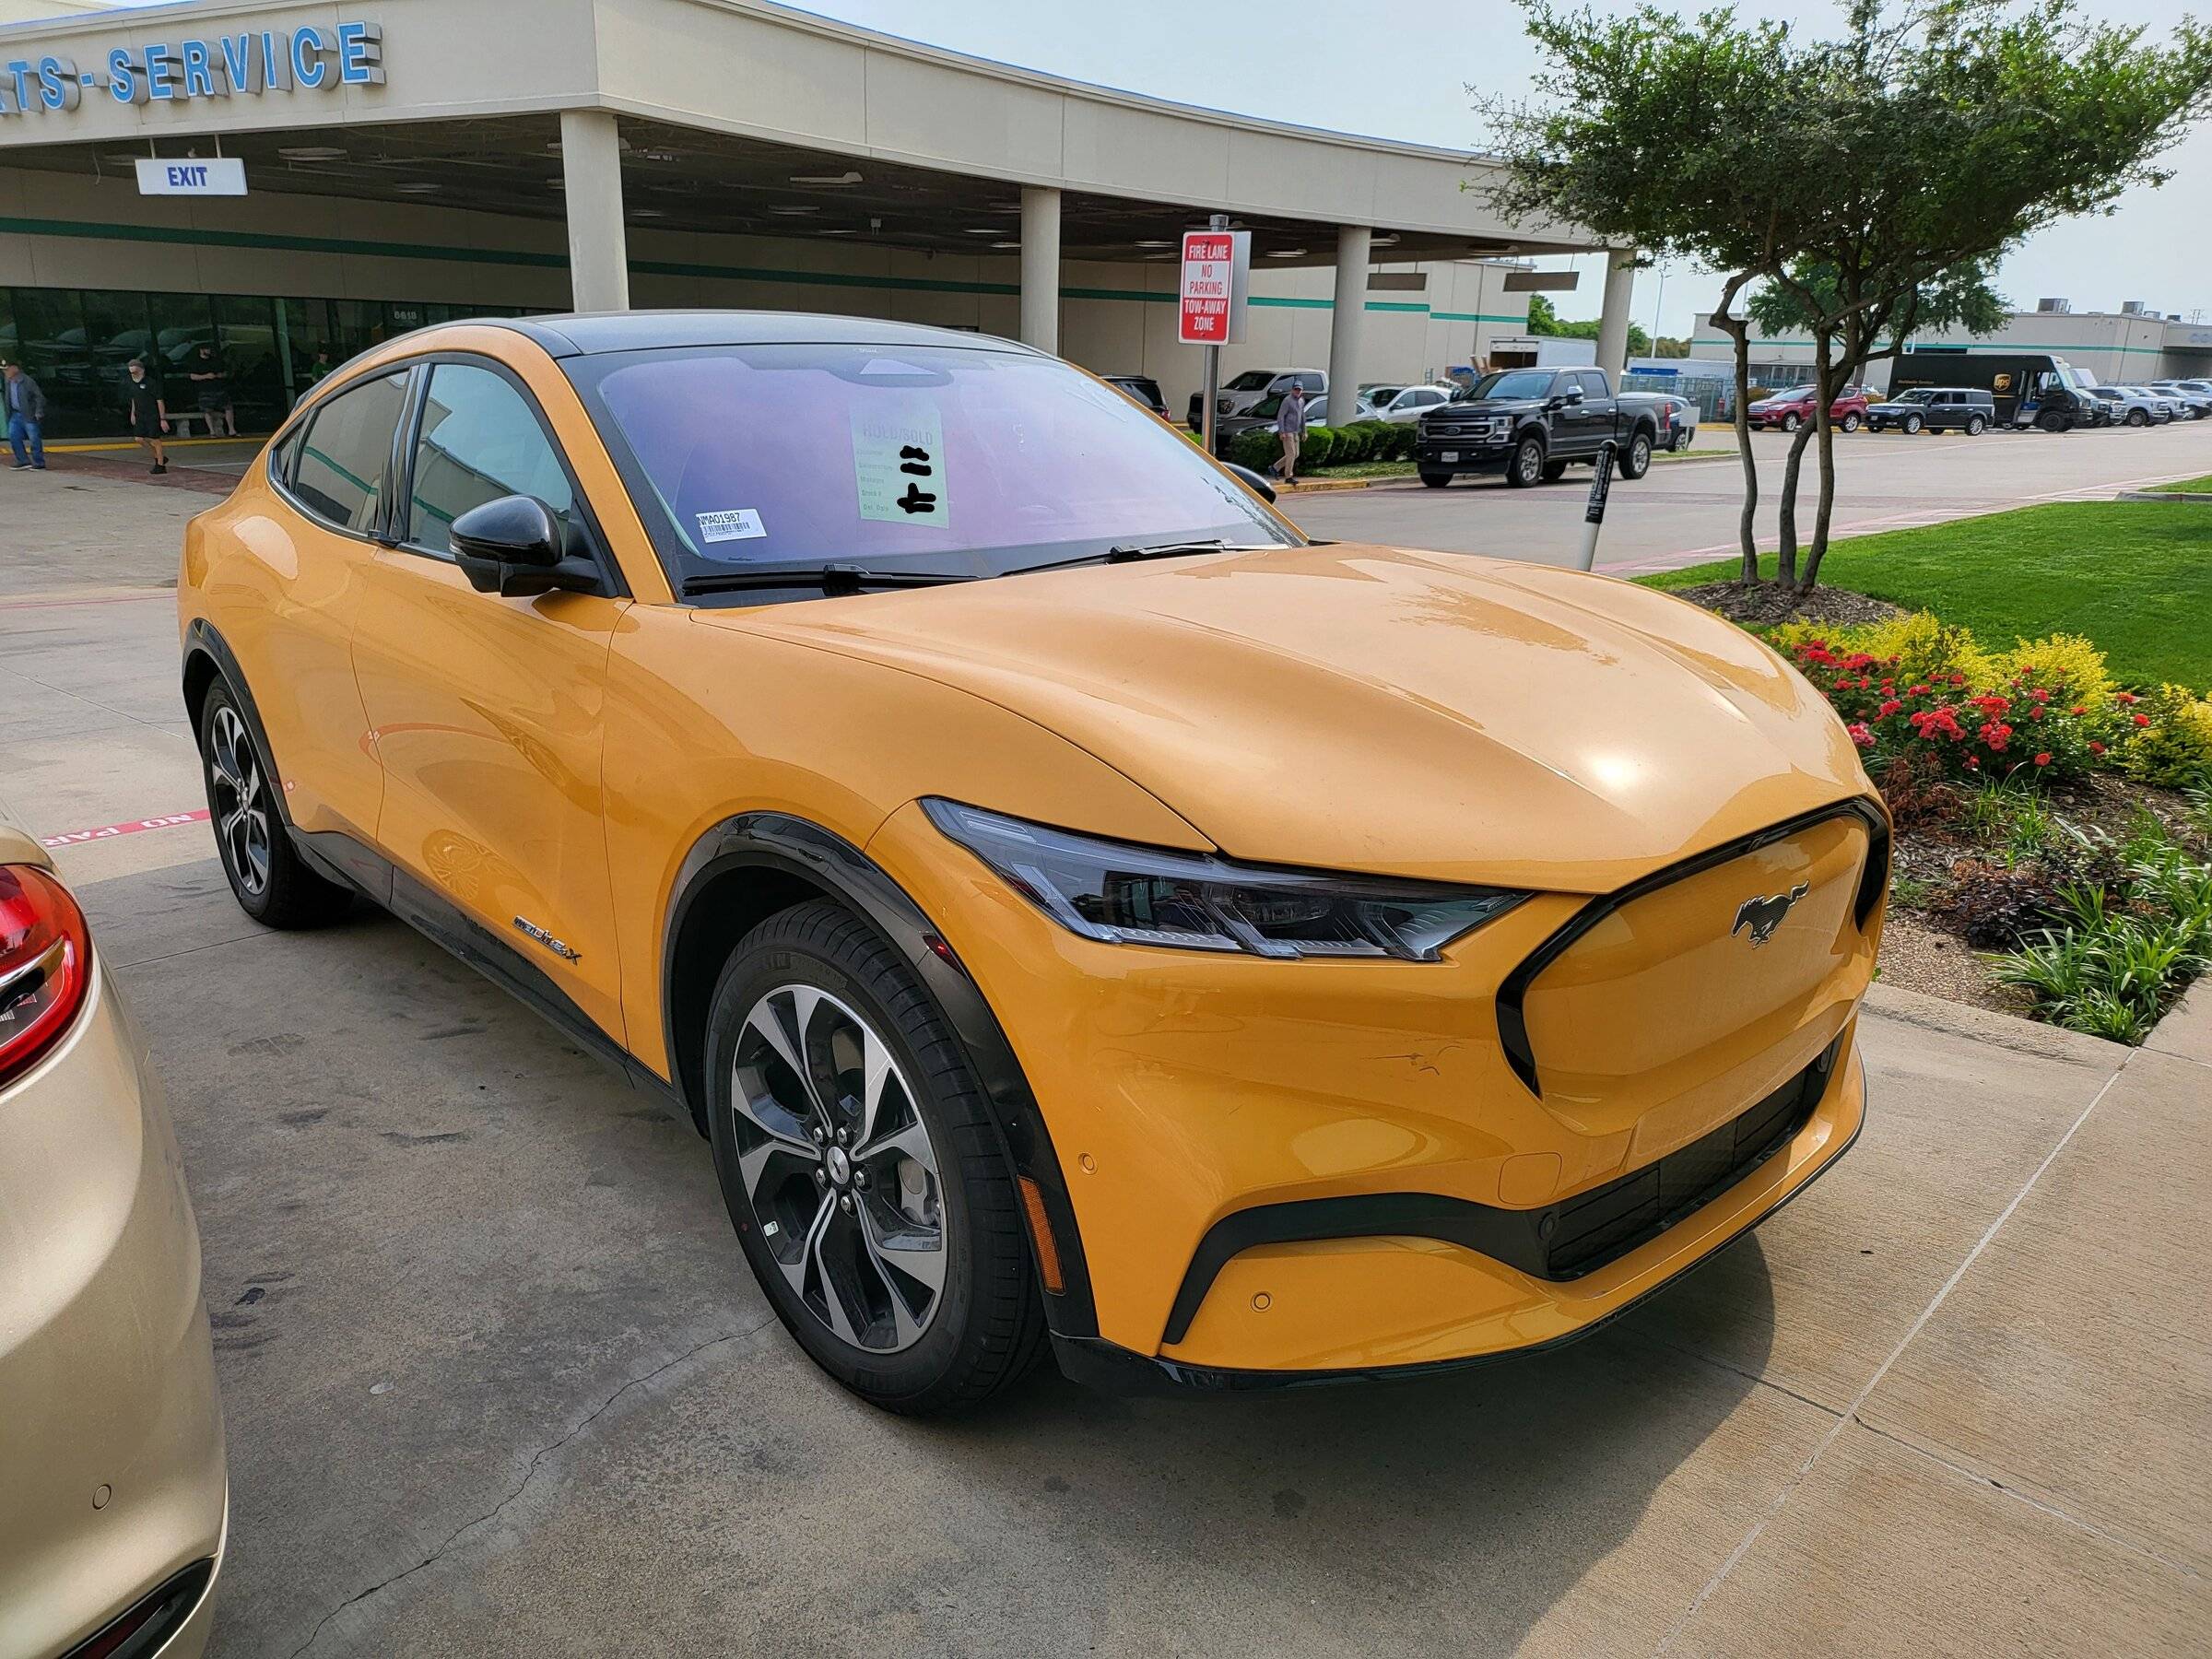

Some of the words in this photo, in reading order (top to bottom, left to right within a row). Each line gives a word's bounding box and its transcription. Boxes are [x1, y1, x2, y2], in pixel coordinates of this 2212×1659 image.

[167, 166, 207, 187] EXIT
[1188, 244, 1206, 259] FIRE
[1207, 244, 1229, 260] LANE
[1201, 264, 1213, 278] NO
[1189, 281, 1223, 295] PARKING
[1184, 299, 1227, 314] TOW-AWAY
[1194, 316, 1215, 331] ZONE
